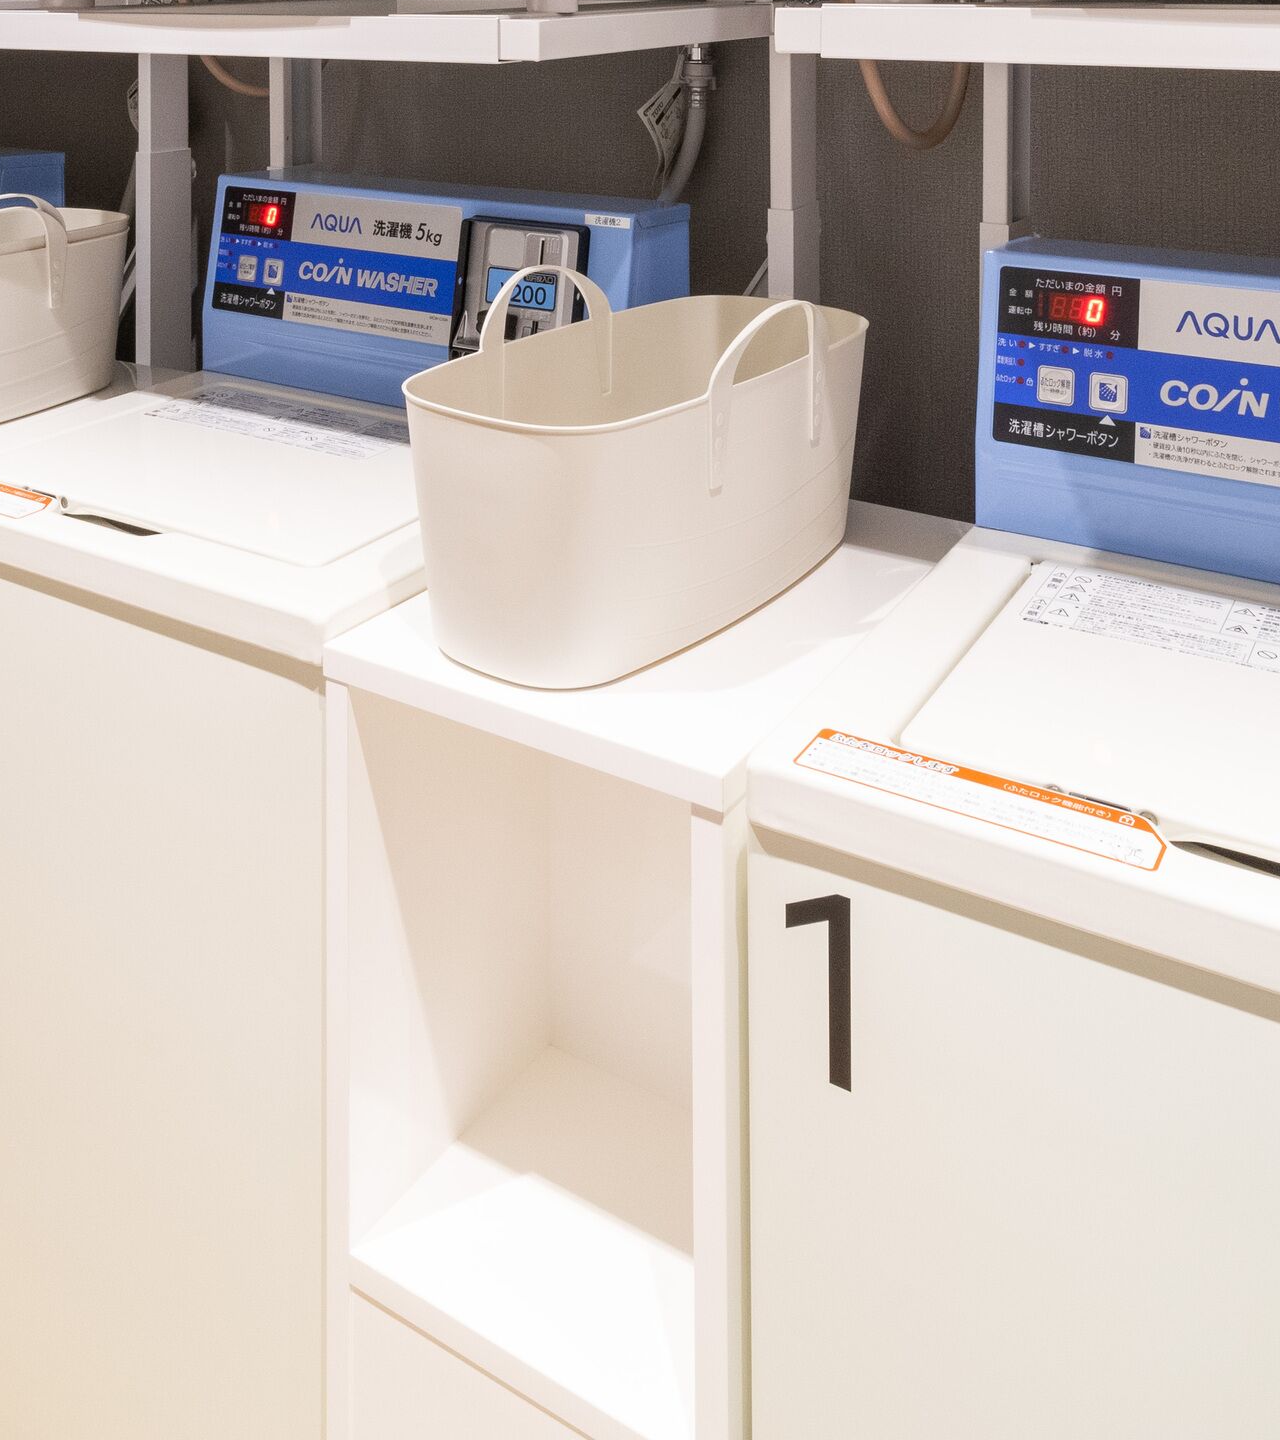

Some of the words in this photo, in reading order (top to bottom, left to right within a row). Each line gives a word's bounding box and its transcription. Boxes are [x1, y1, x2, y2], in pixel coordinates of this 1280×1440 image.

[267, 207, 277, 224] 0
[594, 216, 621, 226] 洗濯機2
[311, 213, 362, 234] AQUA
[373, 220, 412, 240] 洗濯機
[415, 223, 442, 247] 5kg
[356, 268, 439, 298] WASHER
[500, 281, 547, 306] 200
[1035, 278, 1106, 295] ただいまの金額
[1112, 286, 1122, 297] 円
[1008, 305, 1033, 316] 運転中
[1086, 299, 1104, 323] 0
[1110, 330, 1120, 341] 分
[997, 337, 1017, 347] 洗い
[1038, 343, 1061, 353] すすぎ
[1083, 347, 1103, 359] 脱水
[1008, 417, 1119, 448] 洗濯槽シャワーボタン
[1153, 430, 1228, 448] 洗濯槽シャワーボタン
[785, 894, 852, 1093] 1
